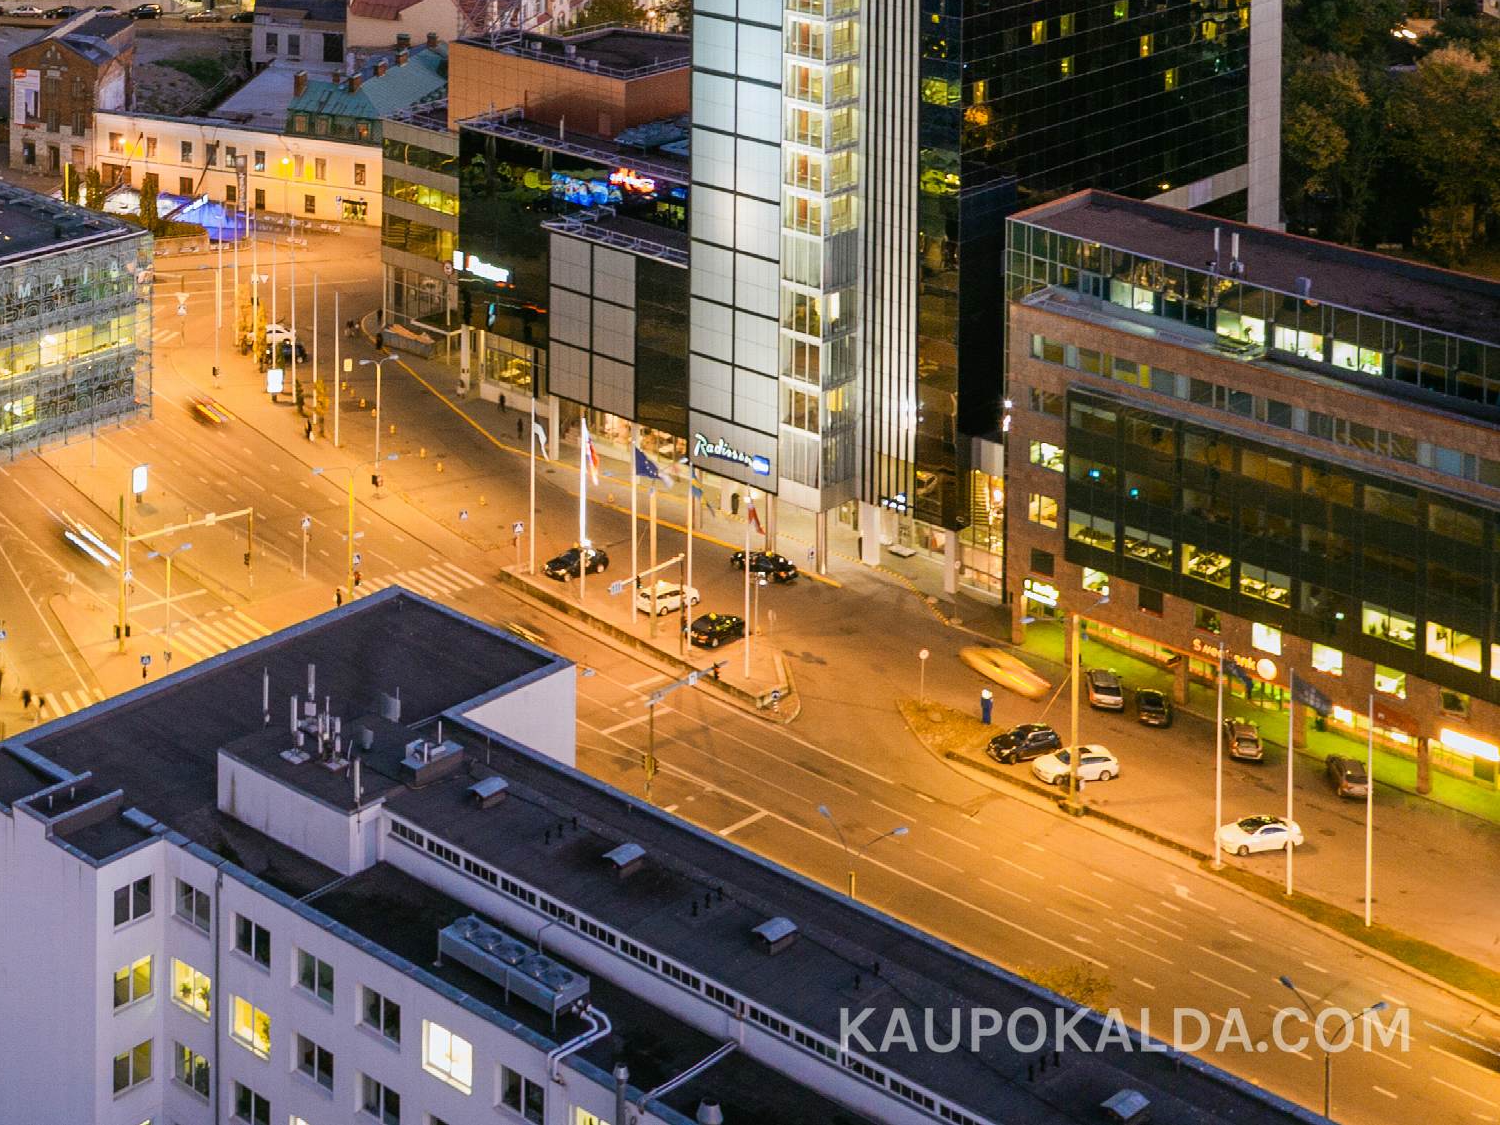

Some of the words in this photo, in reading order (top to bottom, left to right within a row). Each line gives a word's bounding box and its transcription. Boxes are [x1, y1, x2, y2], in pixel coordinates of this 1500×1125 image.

[17, 261, 120, 300] MAJA
[693, 432, 754, 468] Radisson
[1192, 638, 1257, 671] Sweank
